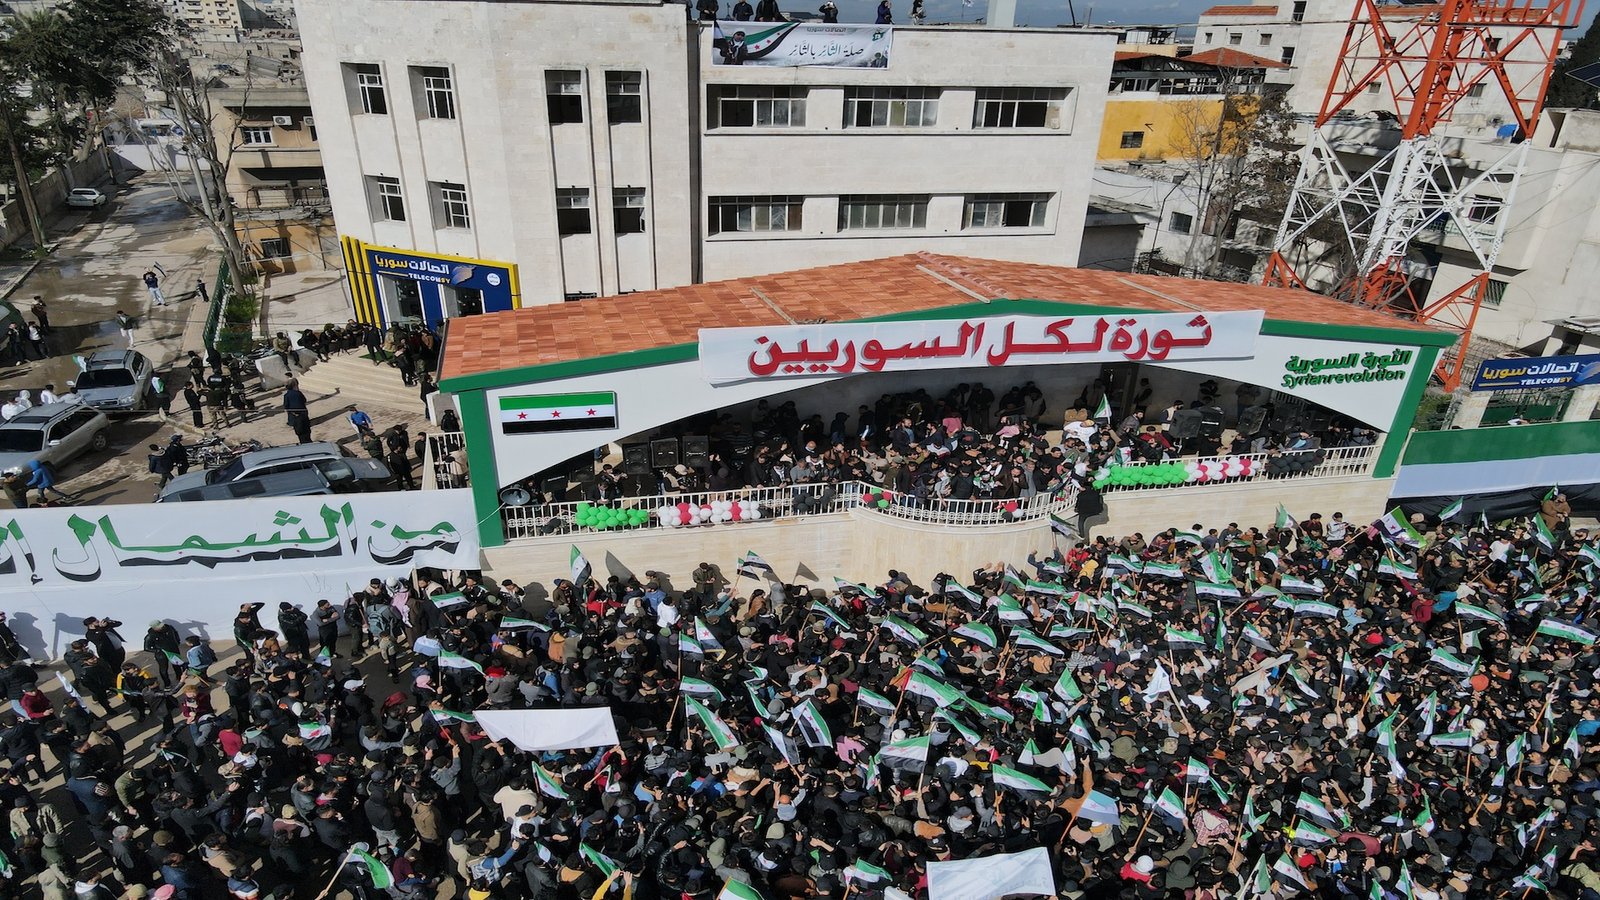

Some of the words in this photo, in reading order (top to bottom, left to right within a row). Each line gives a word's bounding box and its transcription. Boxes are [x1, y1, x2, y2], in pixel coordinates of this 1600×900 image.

[374, 254, 408, 270] سوريا
[408, 259, 450, 275] اتصالات
[408, 272, 451, 284] TELECOMSY
[986, 316, 1110, 367] لكل
[1108, 313, 1213, 361] ثورة
[747, 320, 986, 377] السوريين
[1361, 347, 1413, 370] الثورة
[1285, 352, 1360, 375] السورية
[1482, 366, 1528, 380] سوريا
[1526, 361, 1579, 376] اتصالات
[1281, 368, 1406, 389] Syrianrevolution
[1520, 376, 1573, 386] TELECOMSY
[52, 501, 358, 582] الشمال
[368, 518, 462, 566] من
